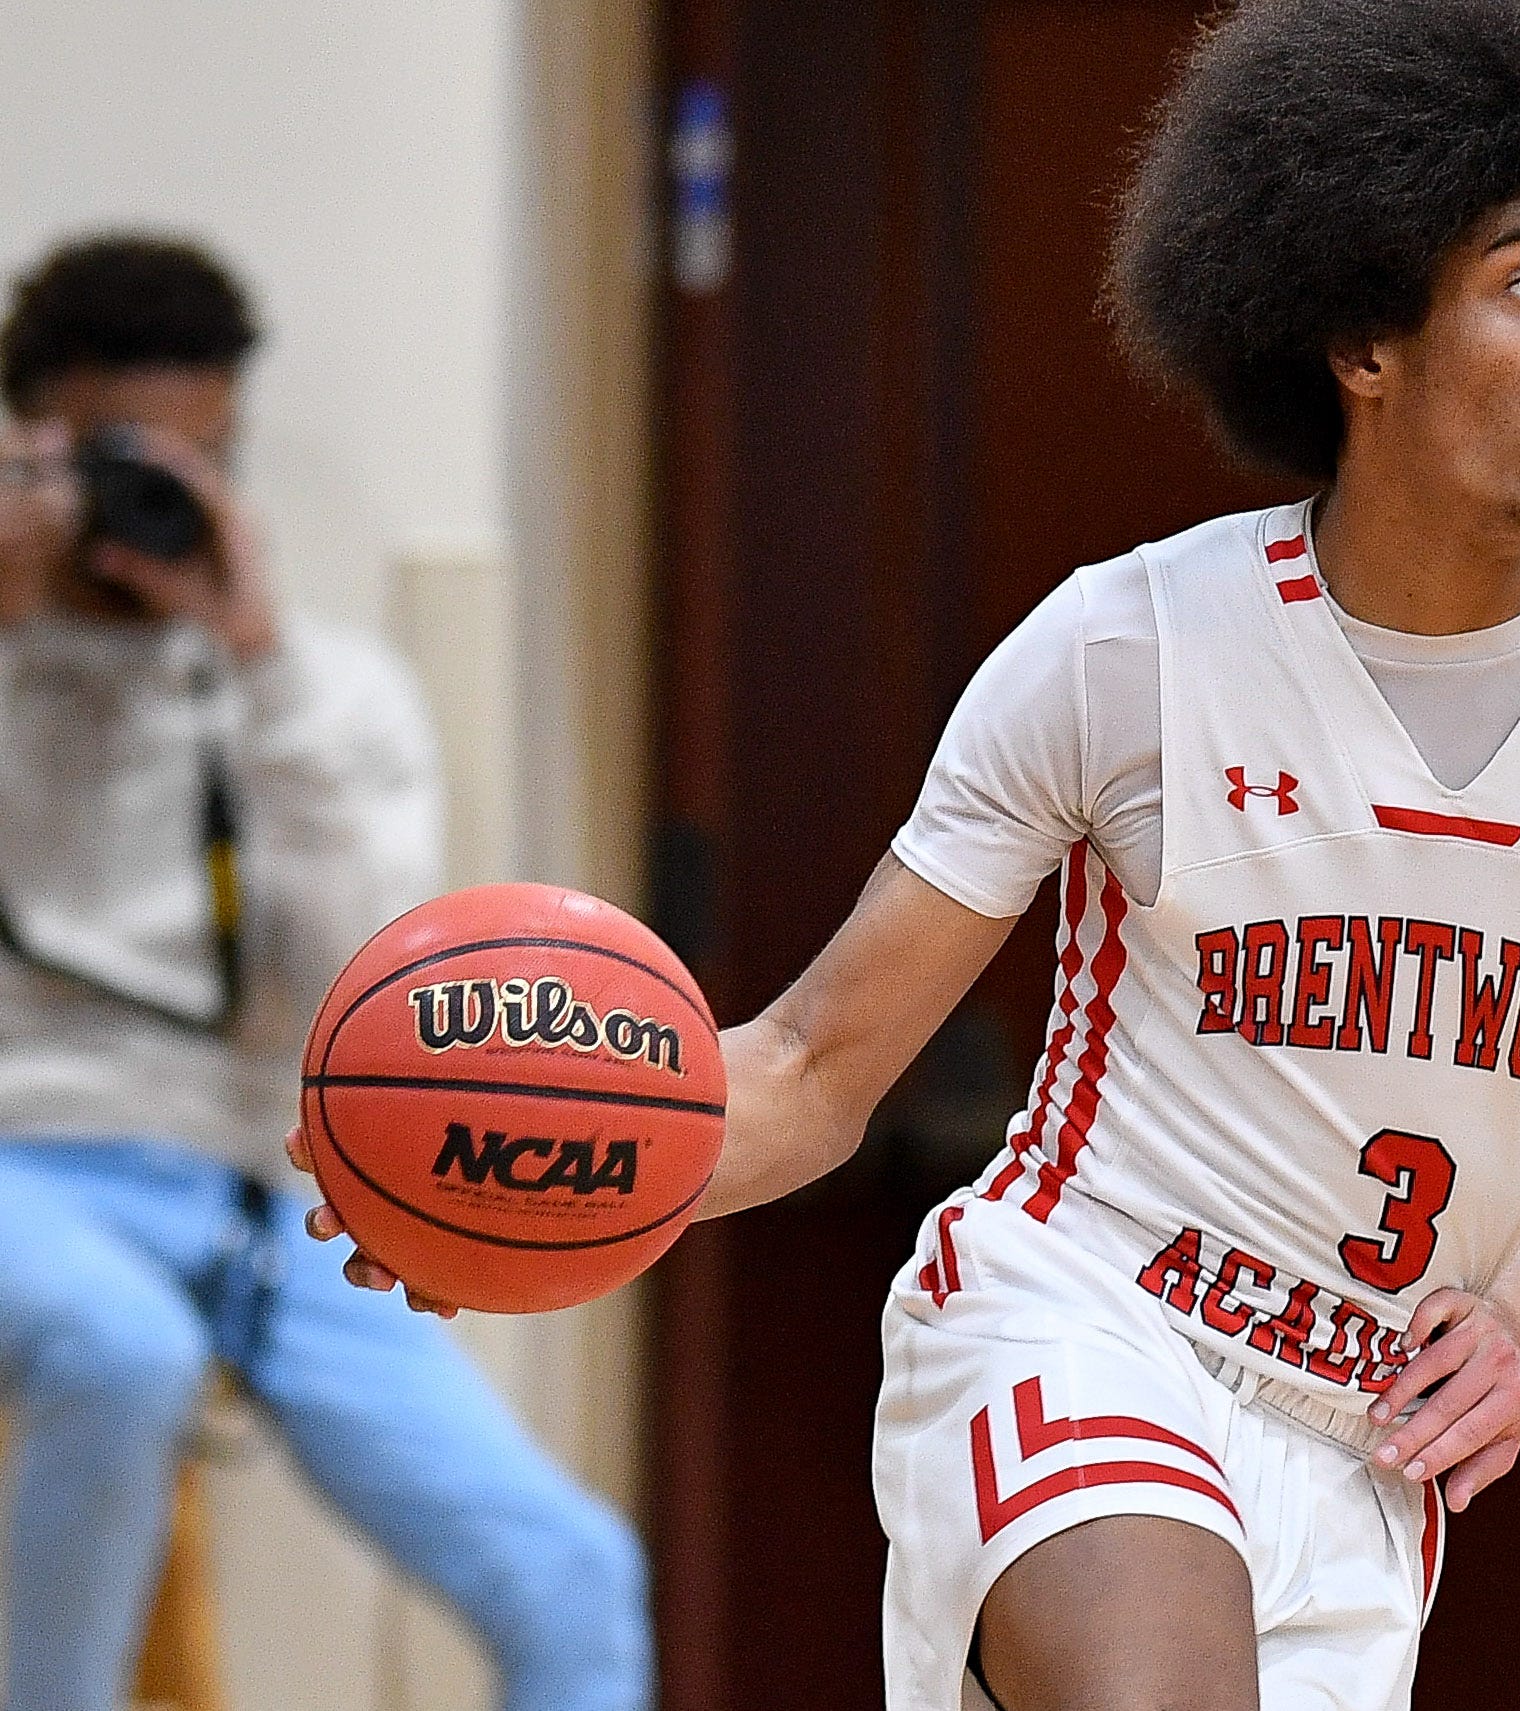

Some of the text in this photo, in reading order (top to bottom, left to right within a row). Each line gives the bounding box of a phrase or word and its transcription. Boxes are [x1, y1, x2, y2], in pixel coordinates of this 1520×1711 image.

[408, 975, 687, 1077] Wilson
[430, 1122, 640, 1195] NCAA
[1338, 1127, 1457, 1295] 3
[1136, 1226, 1412, 1394] ACADE
